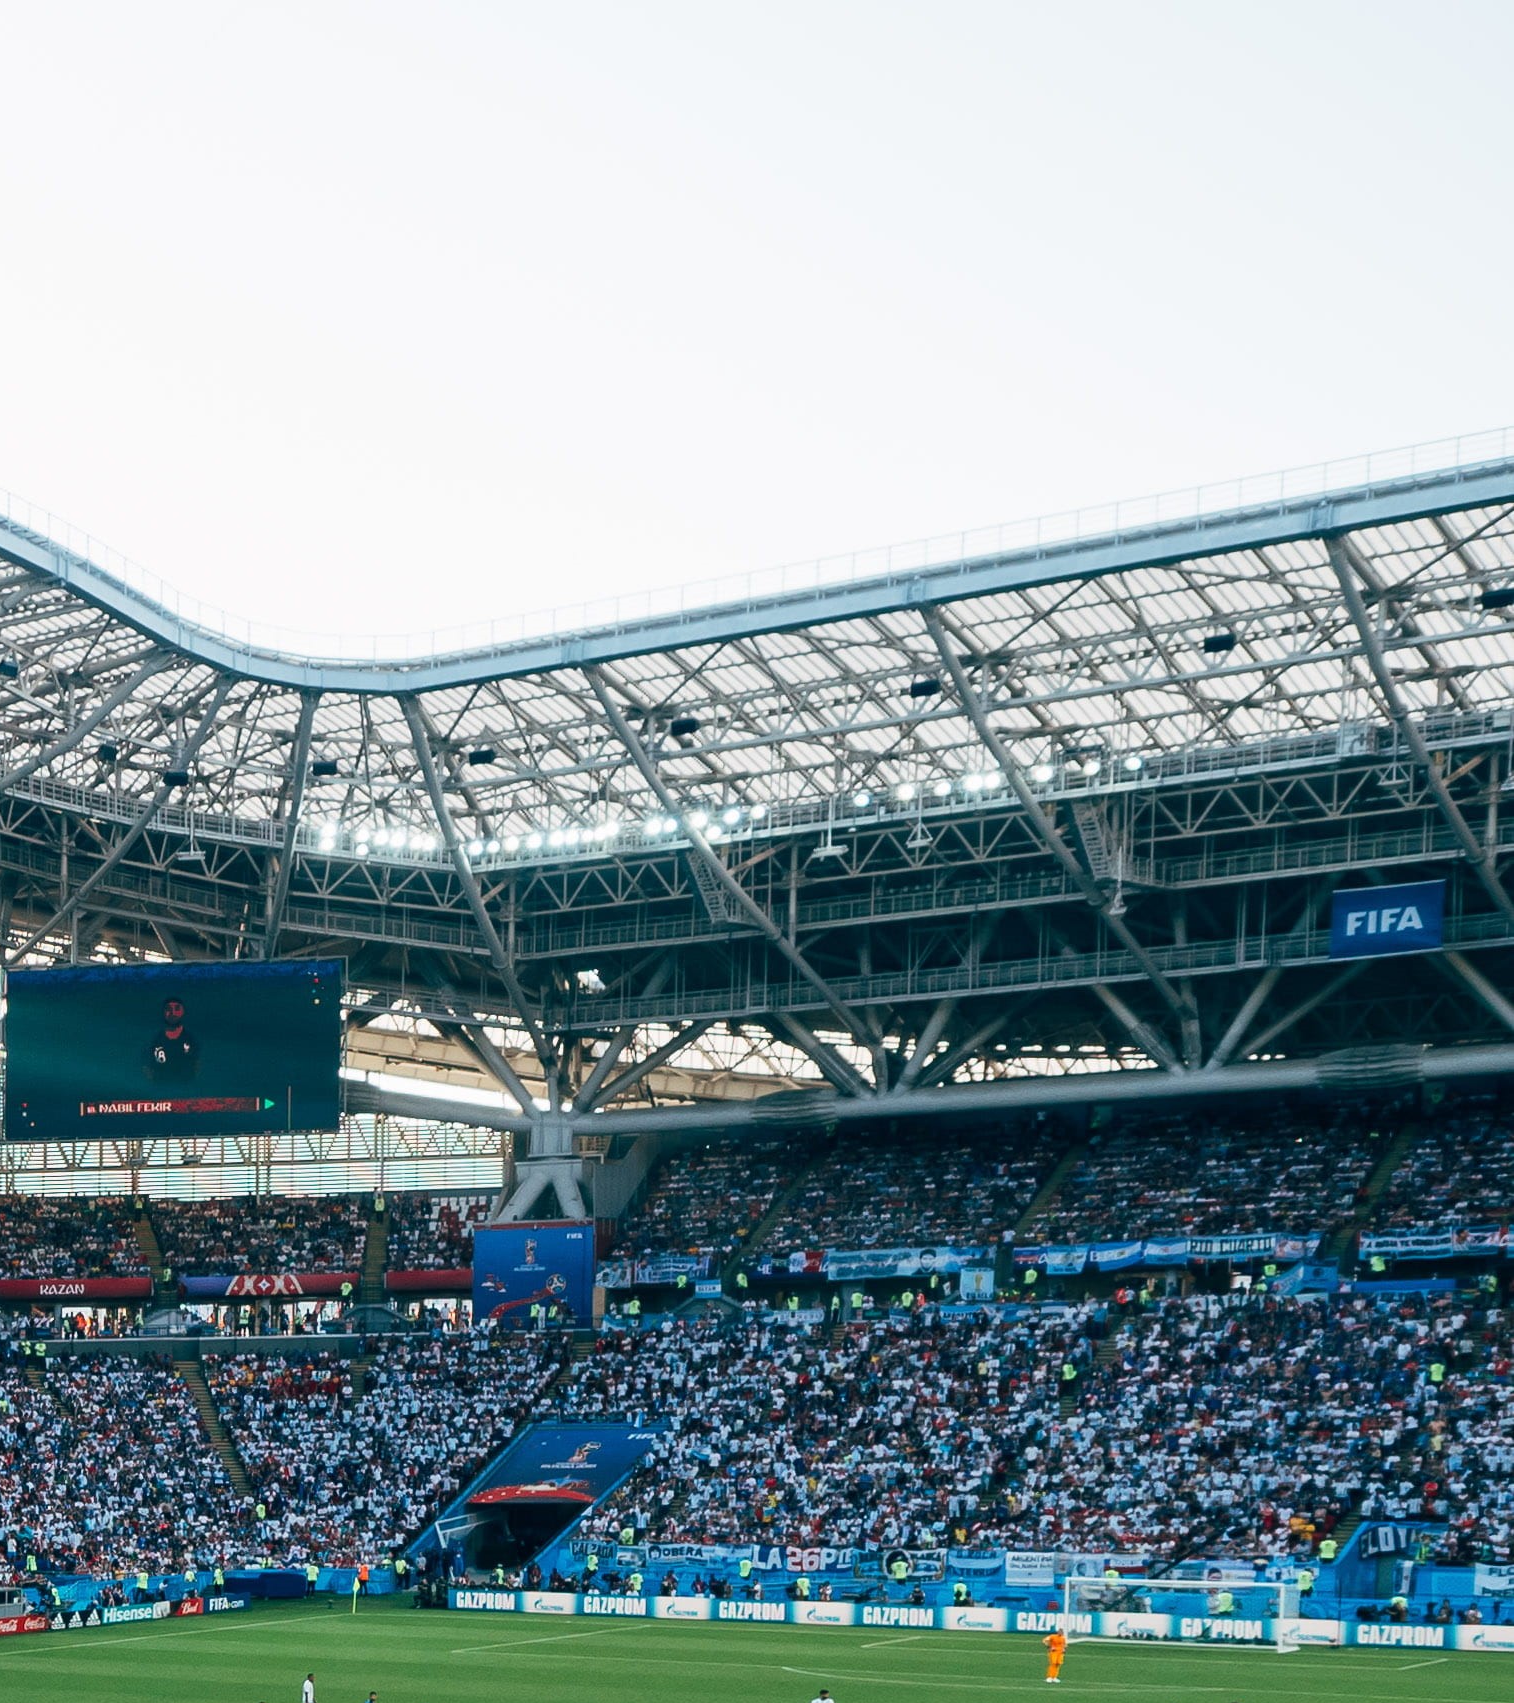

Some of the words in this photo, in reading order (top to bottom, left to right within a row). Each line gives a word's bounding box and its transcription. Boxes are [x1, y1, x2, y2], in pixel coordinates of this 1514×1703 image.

[1346, 906, 1423, 936] FIFA
[98, 1103, 136, 1114] NABIL
[137, 1101, 173, 1113] FEKIR
[39, 1283, 85, 1296] KAZAN
[752, 1545, 783, 1570] LA
[181, 1602, 198, 1615] Bud
[456, 1591, 515, 1610] GAZPROM
[583, 1595, 647, 1615] GAZPROM
[103, 1607, 152, 1623] Hisense
[718, 1601, 785, 1621] GAZPROM
[862, 1606, 934, 1627] GAZPROM
[1356, 1624, 1444, 1647] GAZPROM
